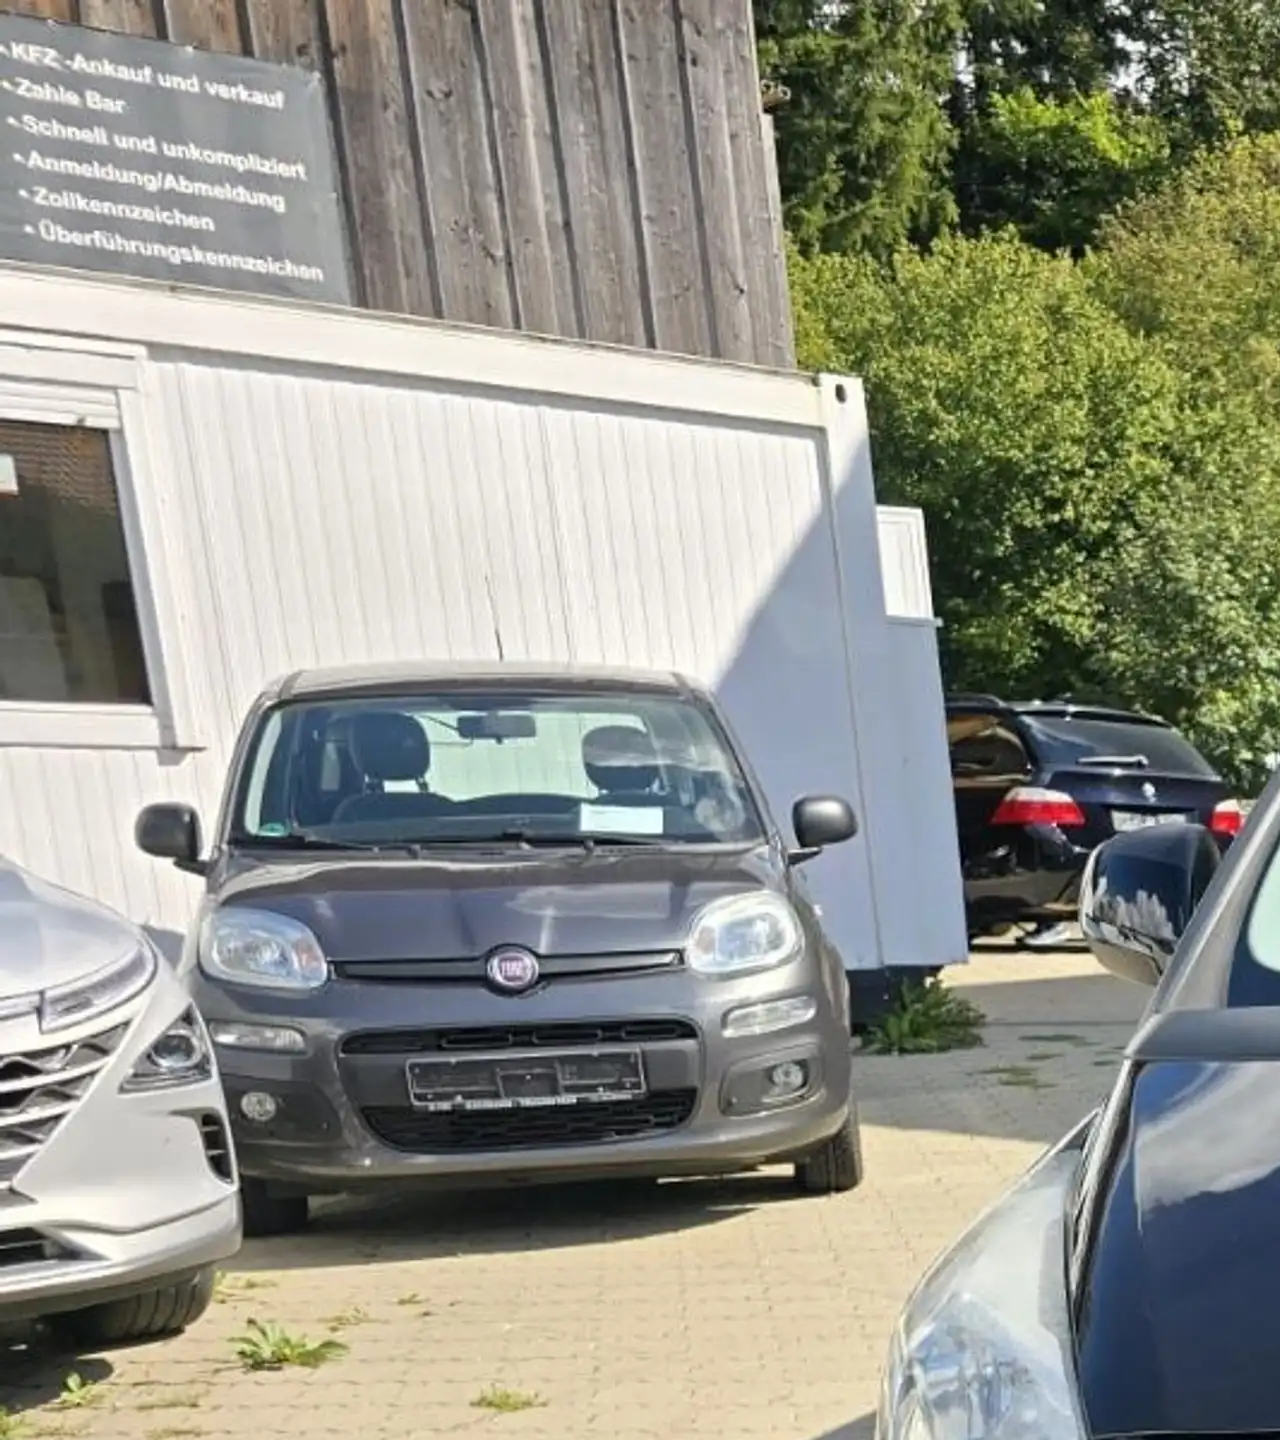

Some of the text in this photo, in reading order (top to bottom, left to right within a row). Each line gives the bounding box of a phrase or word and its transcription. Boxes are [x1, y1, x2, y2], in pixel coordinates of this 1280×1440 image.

[10, 41, 66, 72] KFZ
[156, 74, 199, 94] und
[203, 80, 285, 109] verkauf
[15, 77, 127, 114] Zahle Bar
[21, 114, 308, 181] Schnell und unkompliziert
[27, 151, 287, 213] Anmeldung/Abmeldung
[32, 186, 216, 231] Zollkennzeichen
[38, 218, 324, 283] Überführungskennzeichen
